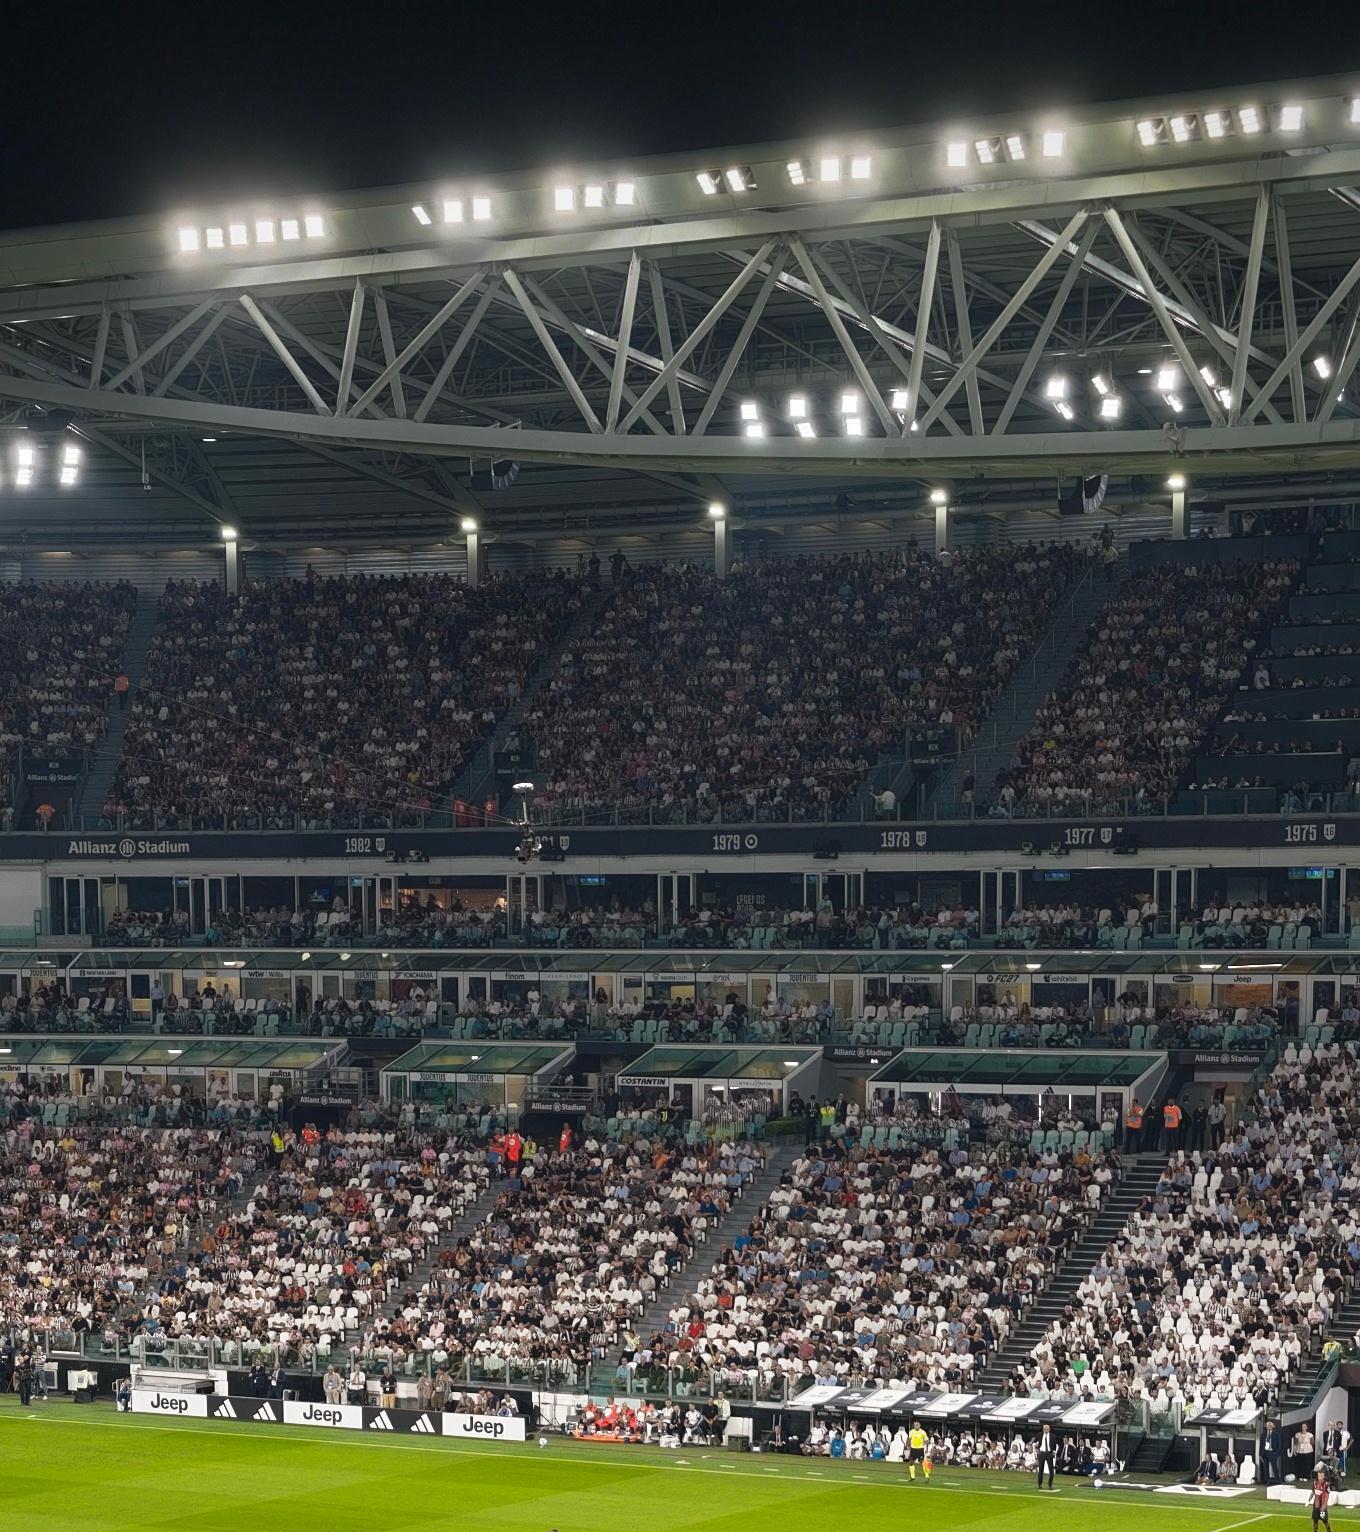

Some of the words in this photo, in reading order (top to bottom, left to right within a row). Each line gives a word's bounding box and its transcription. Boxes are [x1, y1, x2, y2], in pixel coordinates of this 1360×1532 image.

[1064, 828, 1095, 844] 1977
[1285, 825, 1317, 841] 1975
[712, 834, 741, 850] 1979
[880, 831, 910, 848] 1978
[68, 840, 117, 854] Allianz
[137, 840, 190, 854] Stadium
[344, 838, 371, 853] 1982
[29, 969, 58, 977] JUVENTUS
[403, 971, 433, 979] YOKOHAMA
[789, 974, 818, 982] JUVENTUS
[1234, 975, 1252, 984] Jeep
[834, 1048, 857, 1056] Allianz
[865, 1049, 892, 1057] Stadium
[1194, 1054, 1220, 1062] Allianz
[1230, 1055, 1260, 1063] Stadium
[419, 1073, 446, 1081] JUVENTUS
[466, 1074, 494, 1082] JUVENTUS
[621, 1078, 666, 1086] COSTANTIN
[300, 1096, 320, 1104] Allianz
[328, 1097, 352, 1105] Stadium
[531, 1102, 553, 1110] Allianz
[561, 1103, 586, 1111] Stadium
[150, 1393, 189, 1414] Jeep
[303, 1404, 343, 1425] Jeep
[463, 1416, 504, 1438] Jeep
